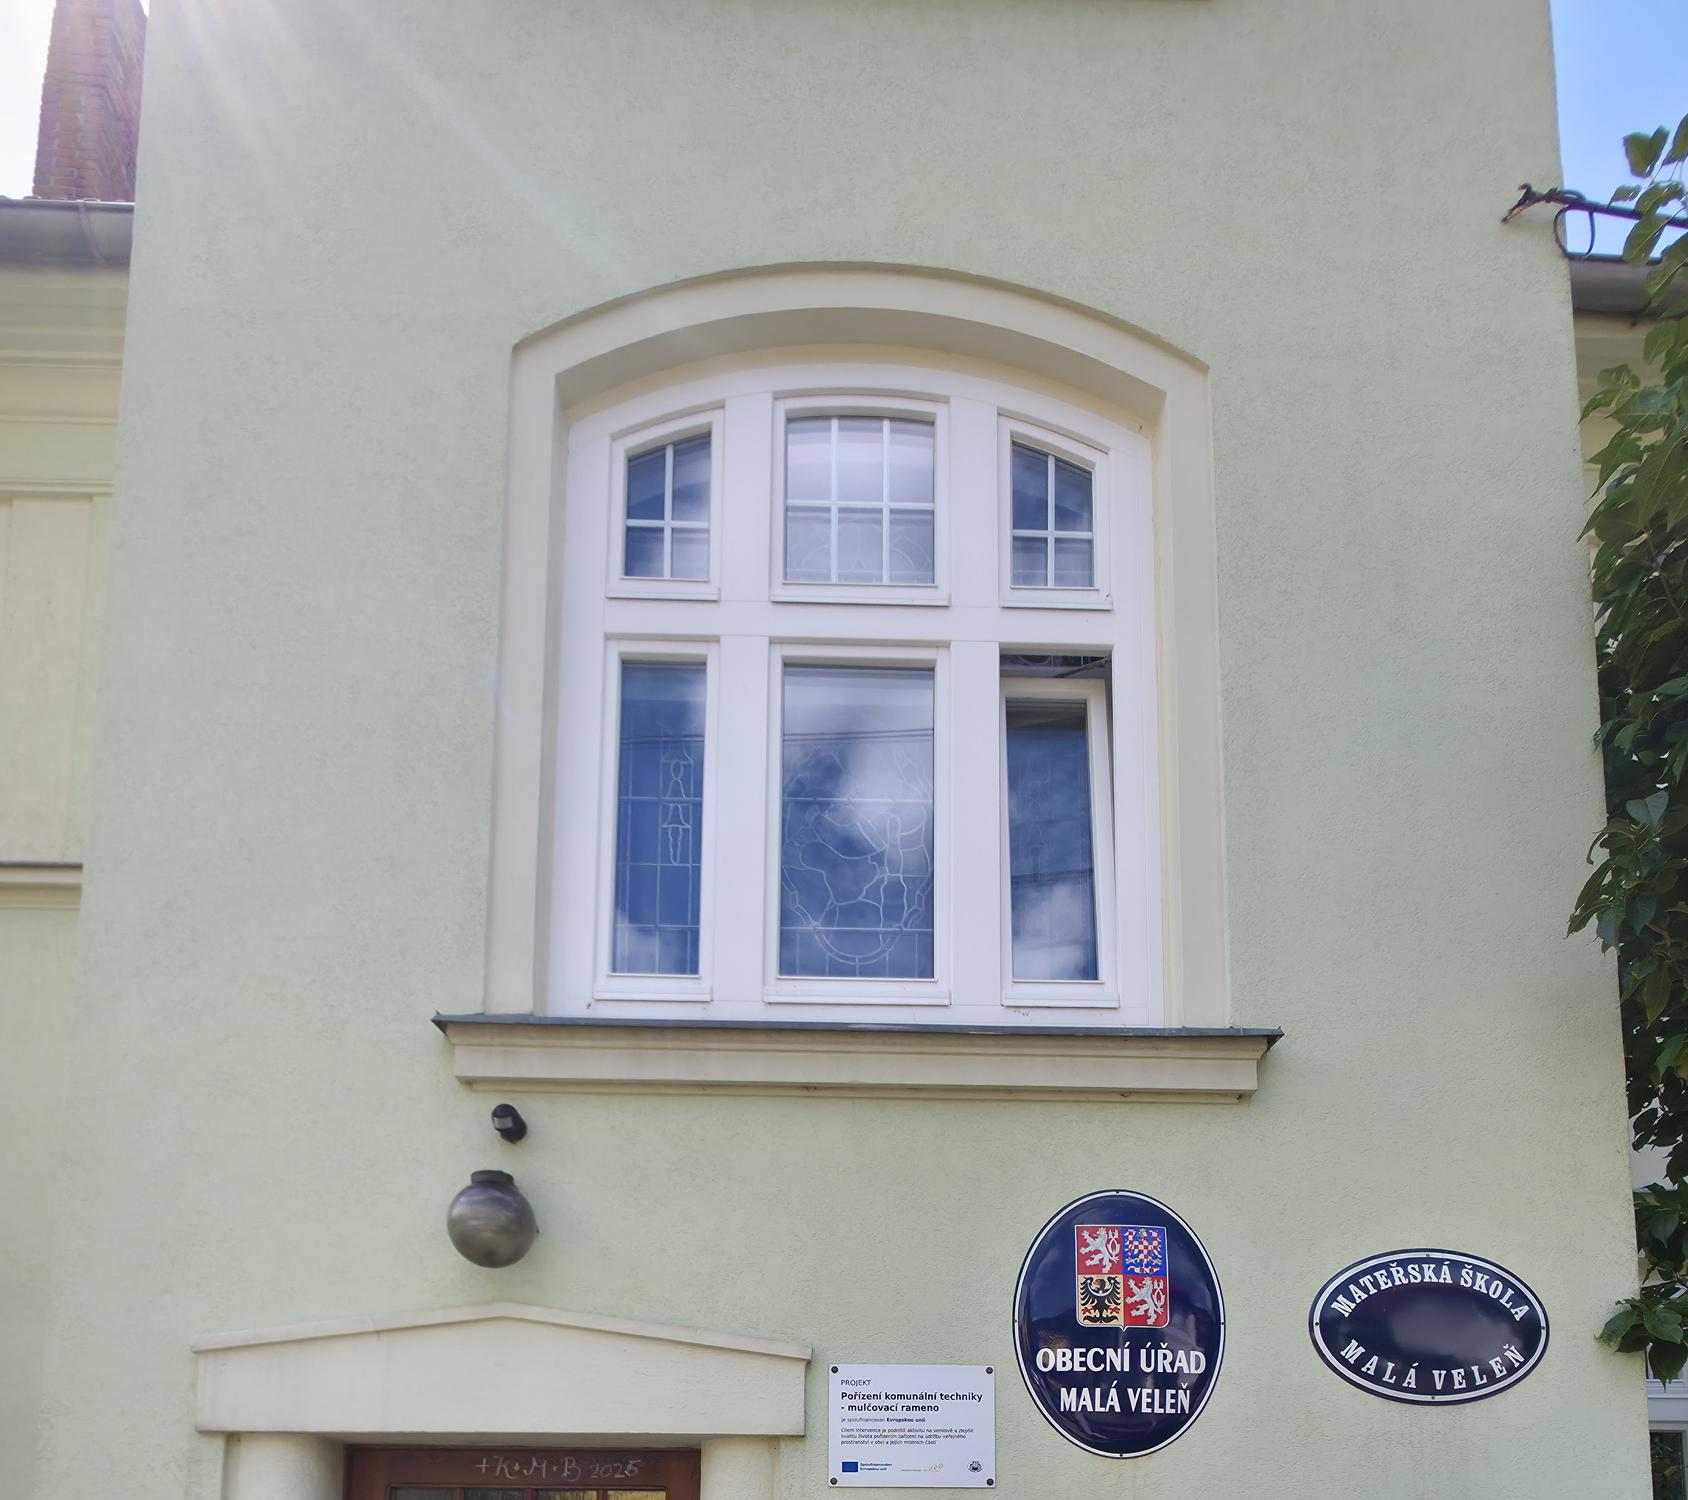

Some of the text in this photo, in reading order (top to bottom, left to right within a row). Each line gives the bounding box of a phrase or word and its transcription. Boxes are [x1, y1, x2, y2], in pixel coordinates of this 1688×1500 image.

[1331, 1261, 1530, 1322] MATEŘSKÁ ŠKOLA
[1035, 1341, 1207, 1374] OBECNÍ ÚŘAD
[1340, 1339, 1526, 1391] MALÁ VELEŇ
[840, 1379, 872, 1387] PROJEKT
[840, 1391, 983, 1402] Pořízení komunální techniky
[1060, 1380, 1191, 1414] MALÁ VELEŇ
[847, 1402, 899, 1412] mulčovací
[900, 1404, 940, 1412] rameno
